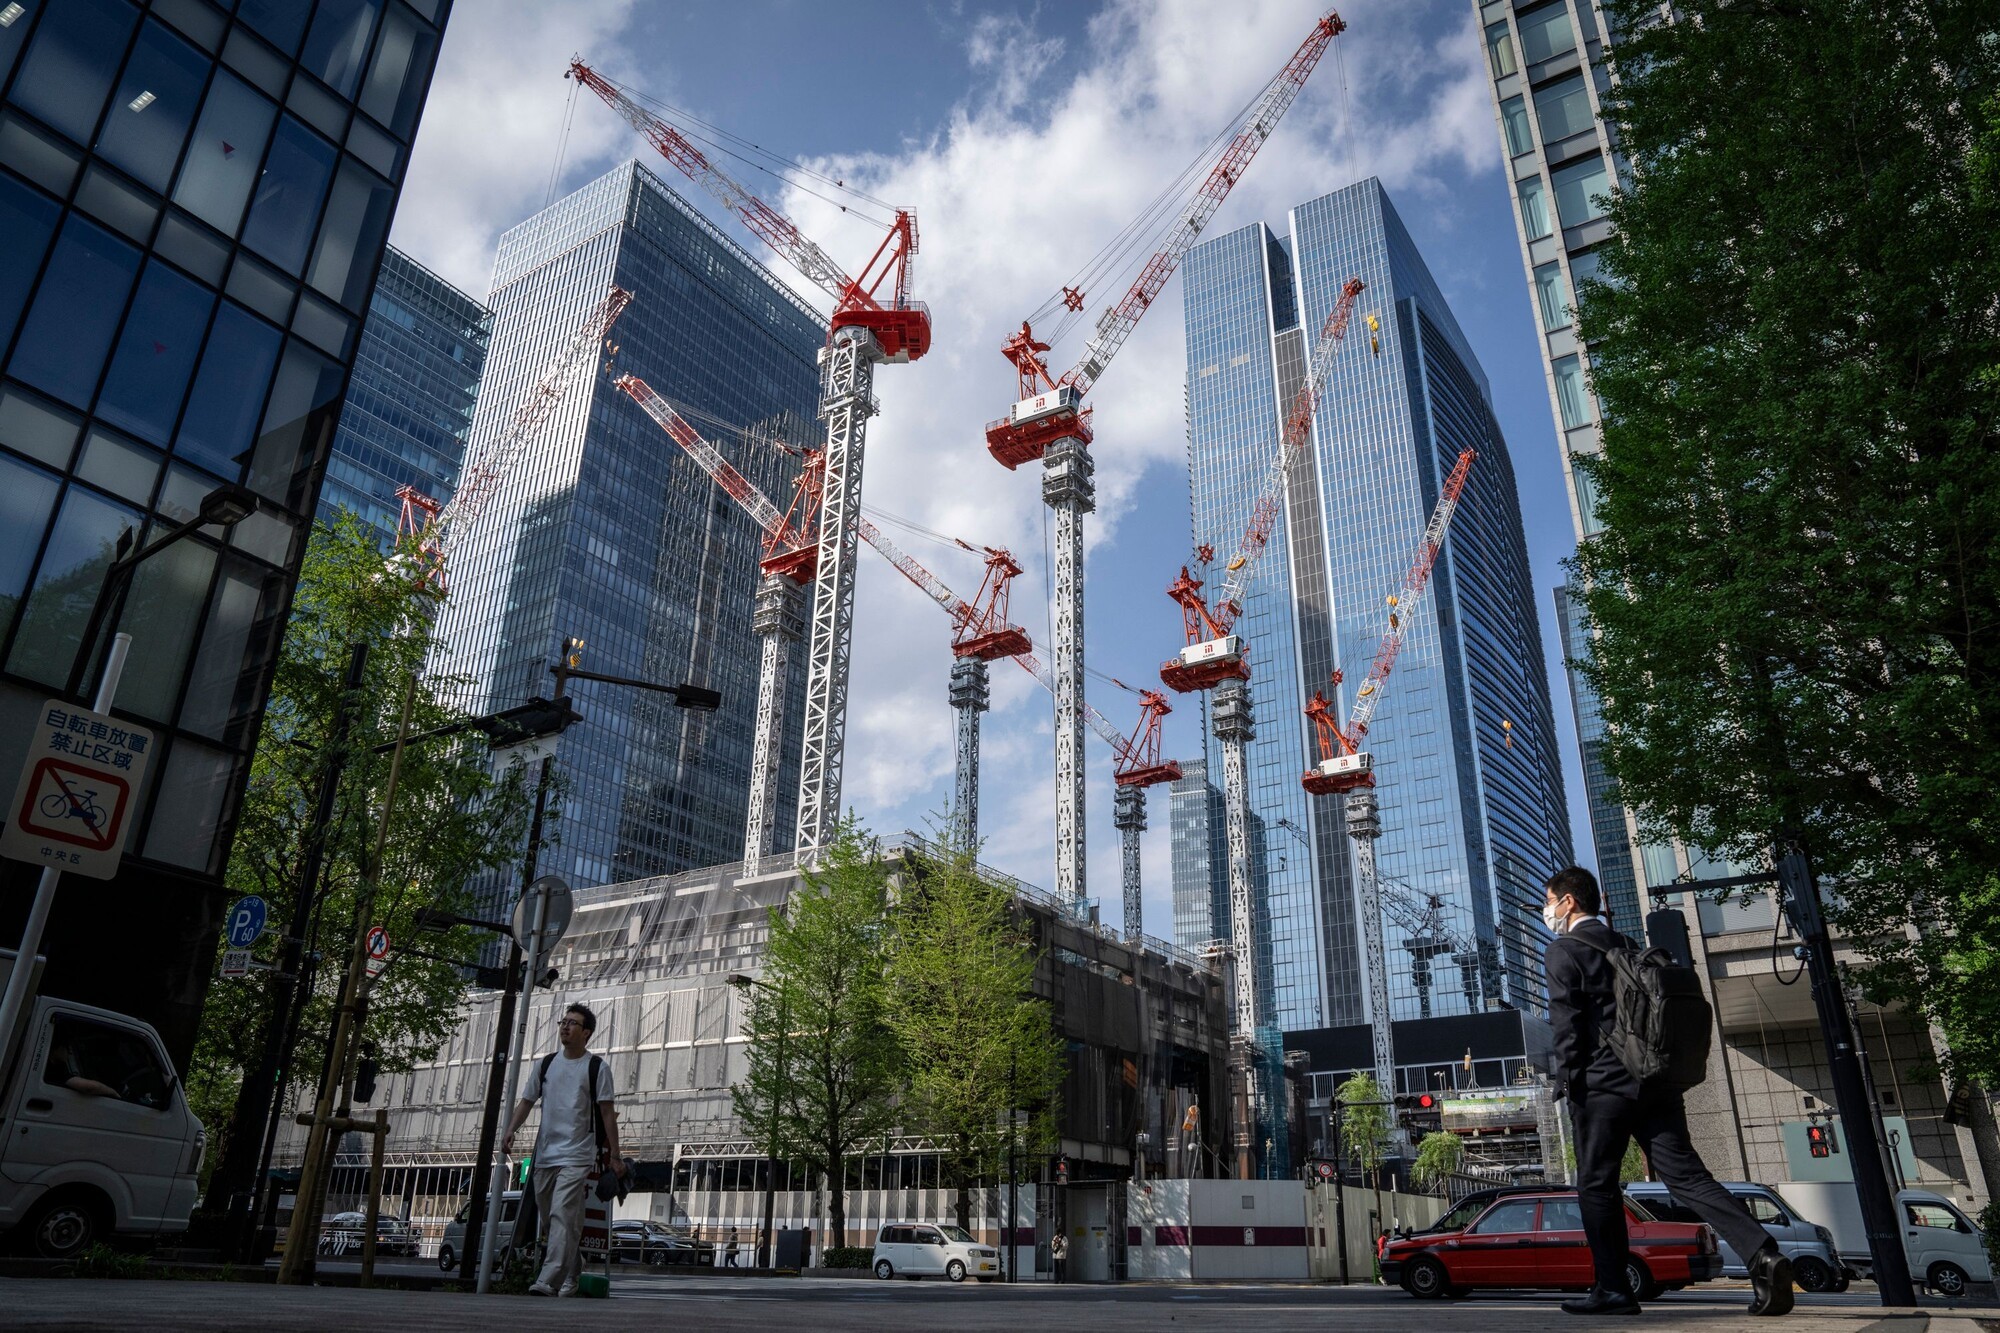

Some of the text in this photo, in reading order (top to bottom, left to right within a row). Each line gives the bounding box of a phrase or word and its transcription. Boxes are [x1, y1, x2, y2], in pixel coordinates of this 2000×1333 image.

[46, 709, 148, 754] 自転車放置
[49, 731, 134, 771] 禁止区域
[40, 846, 82, 865] 中央区
[231, 909, 251, 942] P
